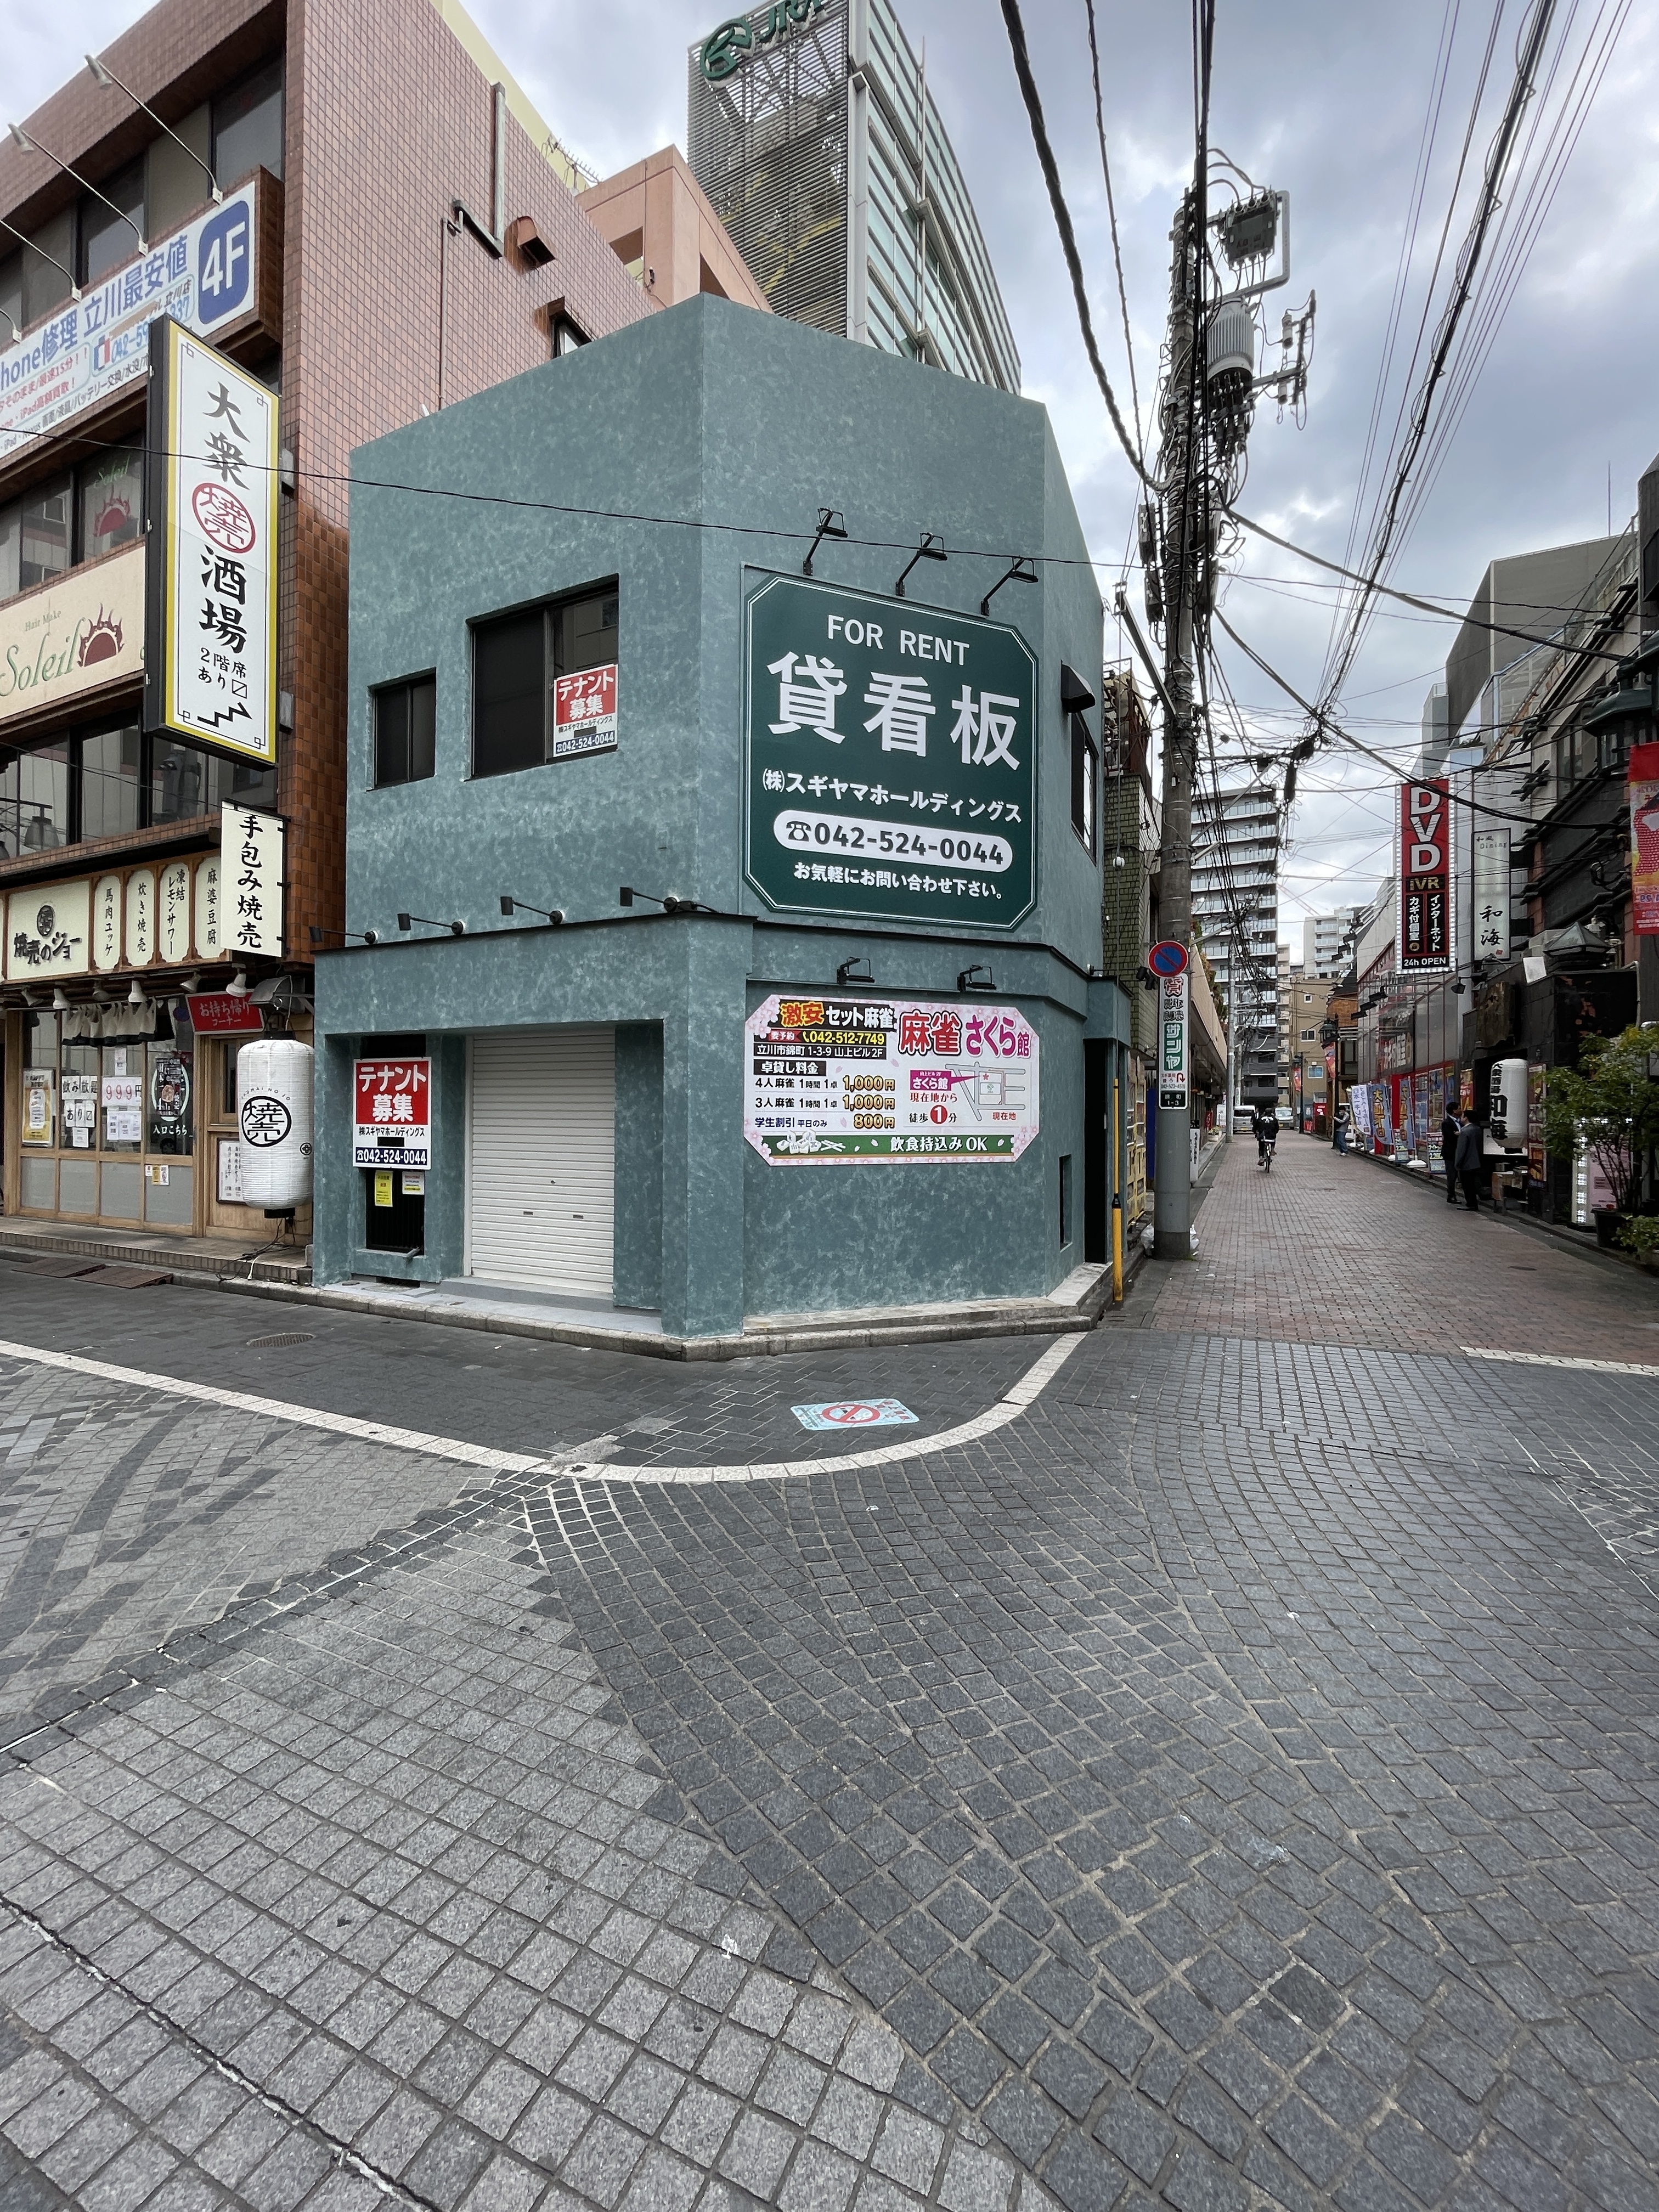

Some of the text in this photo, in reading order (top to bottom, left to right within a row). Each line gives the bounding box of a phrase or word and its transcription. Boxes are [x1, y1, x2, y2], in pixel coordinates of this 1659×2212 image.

[201, 221, 245, 296] 4F
[83, 234, 188, 337] 立川最安値
[201, 381, 251, 491] 大衆
[199, 543, 247, 654] 酒場
[25, 618, 41, 632] Hair
[827, 614, 970, 666] FOR RENT
[0, 617, 86, 697] Soleil
[200, 647, 247, 679] 2階席
[558, 670, 614, 701] テナント
[569, 694, 603, 720] 募集
[766, 651, 1020, 770] 貸看板
[814, 822, 1004, 865] 042-524-0044
[1410, 786, 1441, 873] DVD
[236, 814, 263, 949] 手包み焼売
[793, 861, 1002, 900] お気軽にお問い合わせ下さい。
[137, 882, 146, 953] 炊き焼売
[167, 876, 176, 955] レモンサワー
[206, 868, 218, 945] 麻婆豆腐
[105, 888, 114, 957] 馬肉ユッケ
[1430, 894, 1441, 952] インターネット
[1479, 905, 1504, 946] 和海
[14, 932, 82, 965] 焼売のジョー
[1404, 957, 1447, 967] 24h OPEN
[199, 998, 249, 1018] お持ち帰り
[212, 1015, 241, 1027] コーナー
[780, 1001, 894, 1029] 激安 セット麻雀
[771, 1031, 884, 1045] 要予約 042-512-7749
[899, 1011, 1031, 1058] 麻雀 さくら館
[757, 1045, 805, 1057] 立川市錦町
[808, 1046, 832, 1056] 1-3-9
[359, 1064, 427, 1092] テナント
[761, 1061, 819, 1074] 卓貸し料金
[106, 1085, 141, 1101] 999円
[755, 1077, 795, 1088] 4人麻雀
[799, 1079, 821, 1088] 1時間
[842, 1075, 895, 1092] 1,000円
[910, 1092, 957, 1103] 現在地から
[912, 1077, 948, 1090] さくら館
[372, 1093, 414, 1122] 募集
[755, 1098, 795, 1109] 3人麻雀
[799, 1099, 821, 1109] 1時間
[842, 1094, 895, 1111] 1,000円
[992, 1112, 1017, 1120] 現在地
[153, 1124, 188, 1136] 入口こちら
[755, 1114, 895, 1129] 学生割引 平日のみ 800円
[364, 1148, 426, 1164] 042-524-0044
[890, 1137, 988, 1152] 飲食持込み OK
